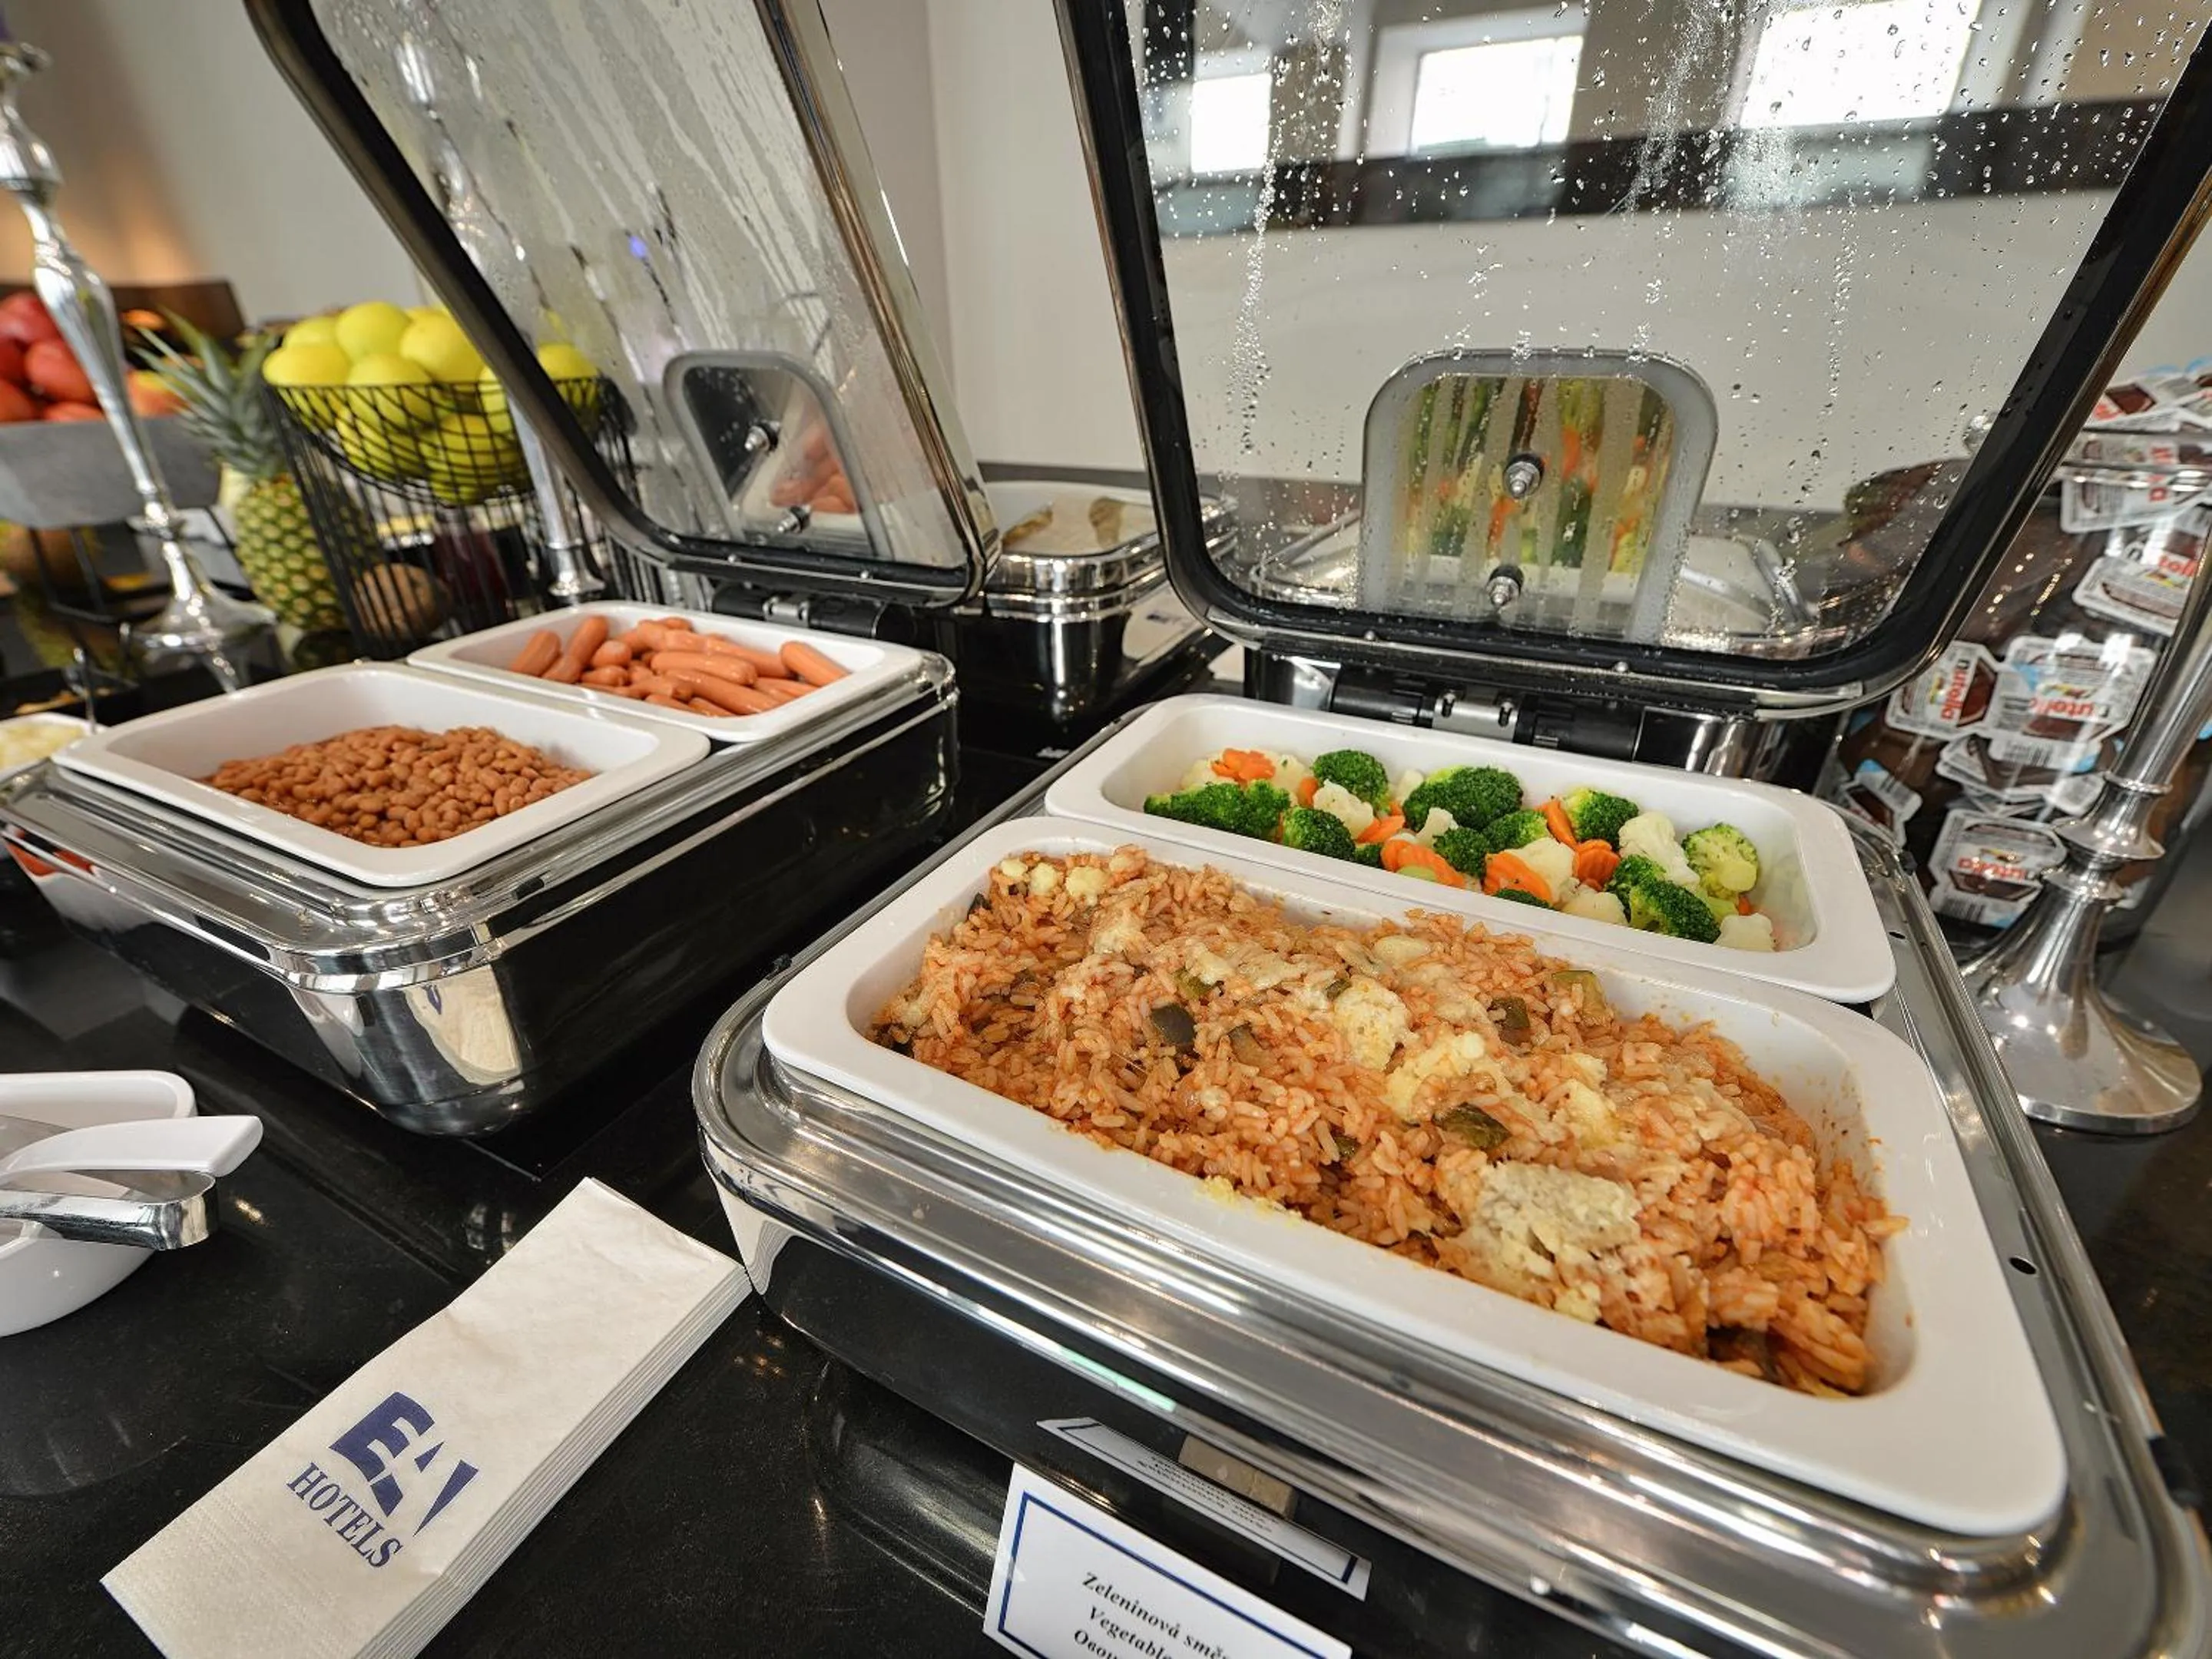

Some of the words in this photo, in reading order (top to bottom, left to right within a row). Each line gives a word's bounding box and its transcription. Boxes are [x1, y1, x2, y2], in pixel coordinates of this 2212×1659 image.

[1941, 659, 1970, 720] nutella
[286, 1462, 403, 1568] HOTELS
[1082, 1571, 1181, 1639] Zeleninová
[1184, 1634, 1232, 1659] smě
